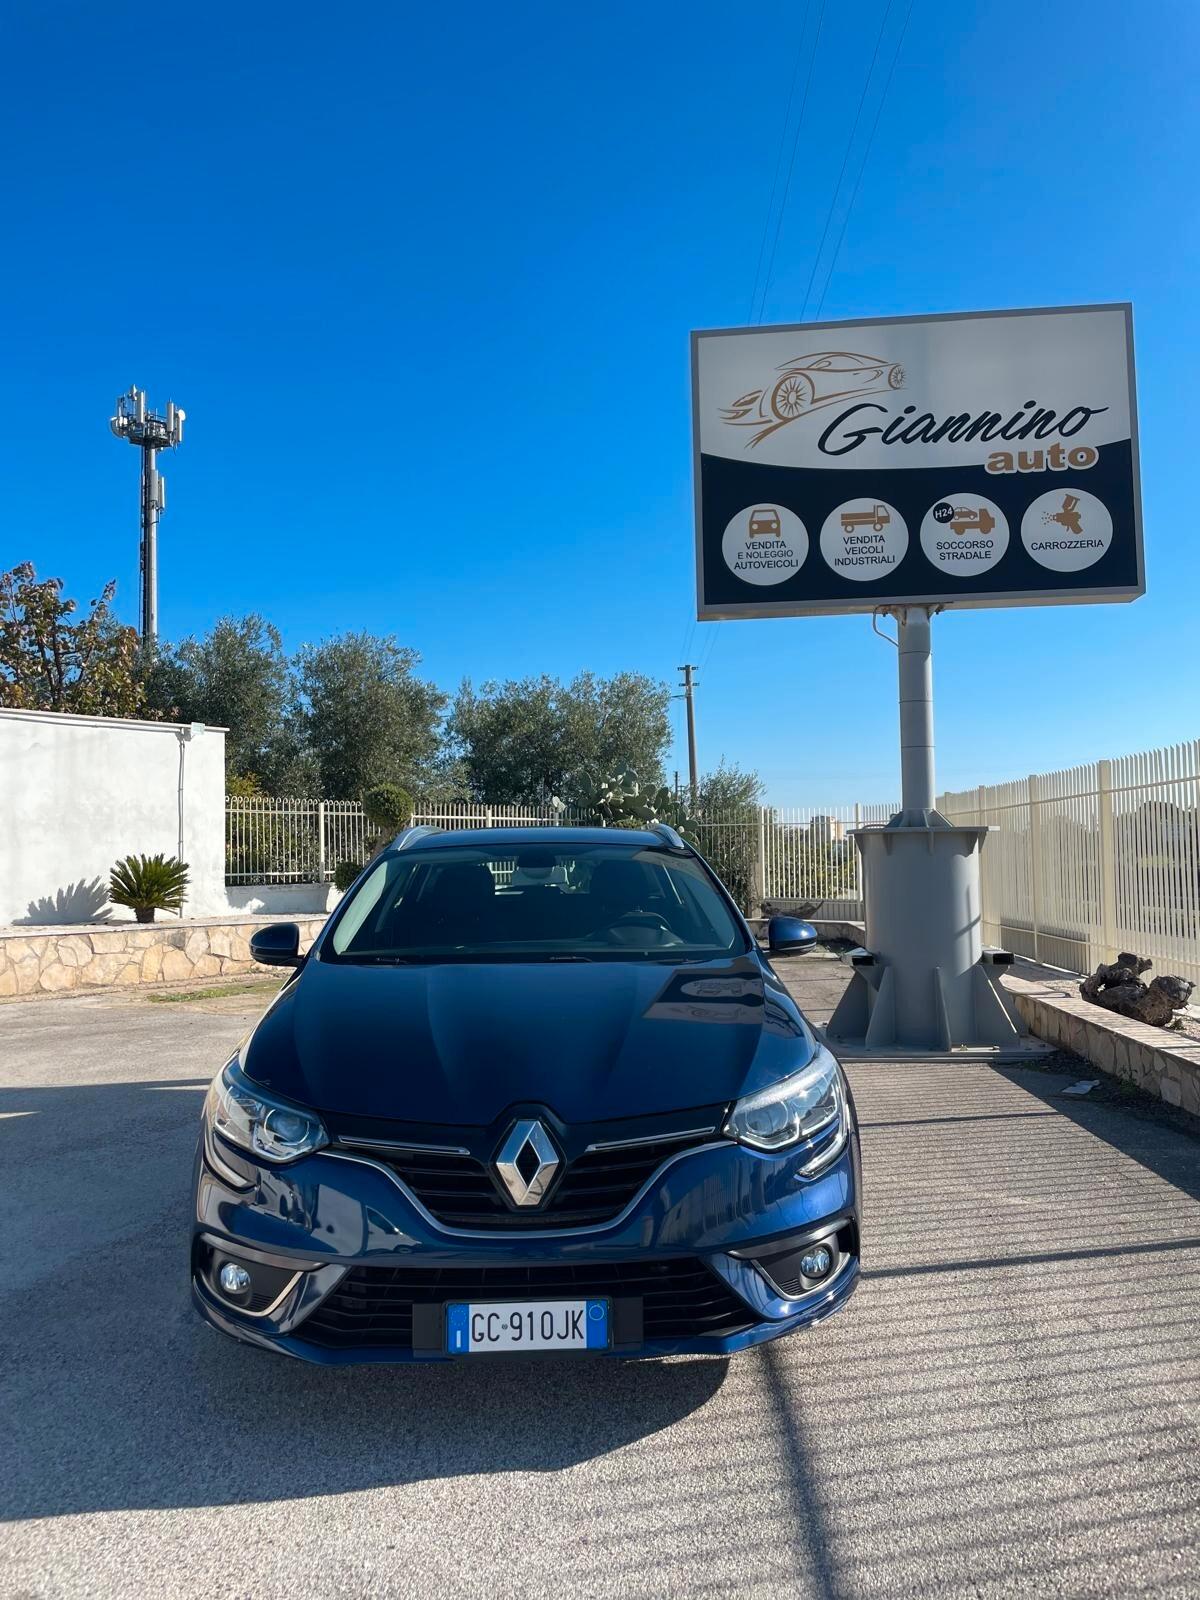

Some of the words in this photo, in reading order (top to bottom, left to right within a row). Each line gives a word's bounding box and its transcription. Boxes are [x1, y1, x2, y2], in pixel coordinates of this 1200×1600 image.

[818, 400, 1109, 456] Giannino
[987, 442, 1097, 472] auto
[934, 506, 953, 519] H24
[745, 540, 787, 550] VENDITA
[843, 535, 885, 545] VENDITA
[936, 540, 994, 550] SOCCORSO
[1031, 539, 1104, 551] CARROZZERIA
[737, 552, 744, 560] E
[746, 550, 793, 559] NOLEGGIO
[845, 546, 884, 555] VEICOLI
[939, 550, 992, 561] STRADALE
[734, 560, 799, 570] AUTOVEICOLI
[834, 555, 896, 566] INDUSTRIALI
[471, 1312, 500, 1342] GC
